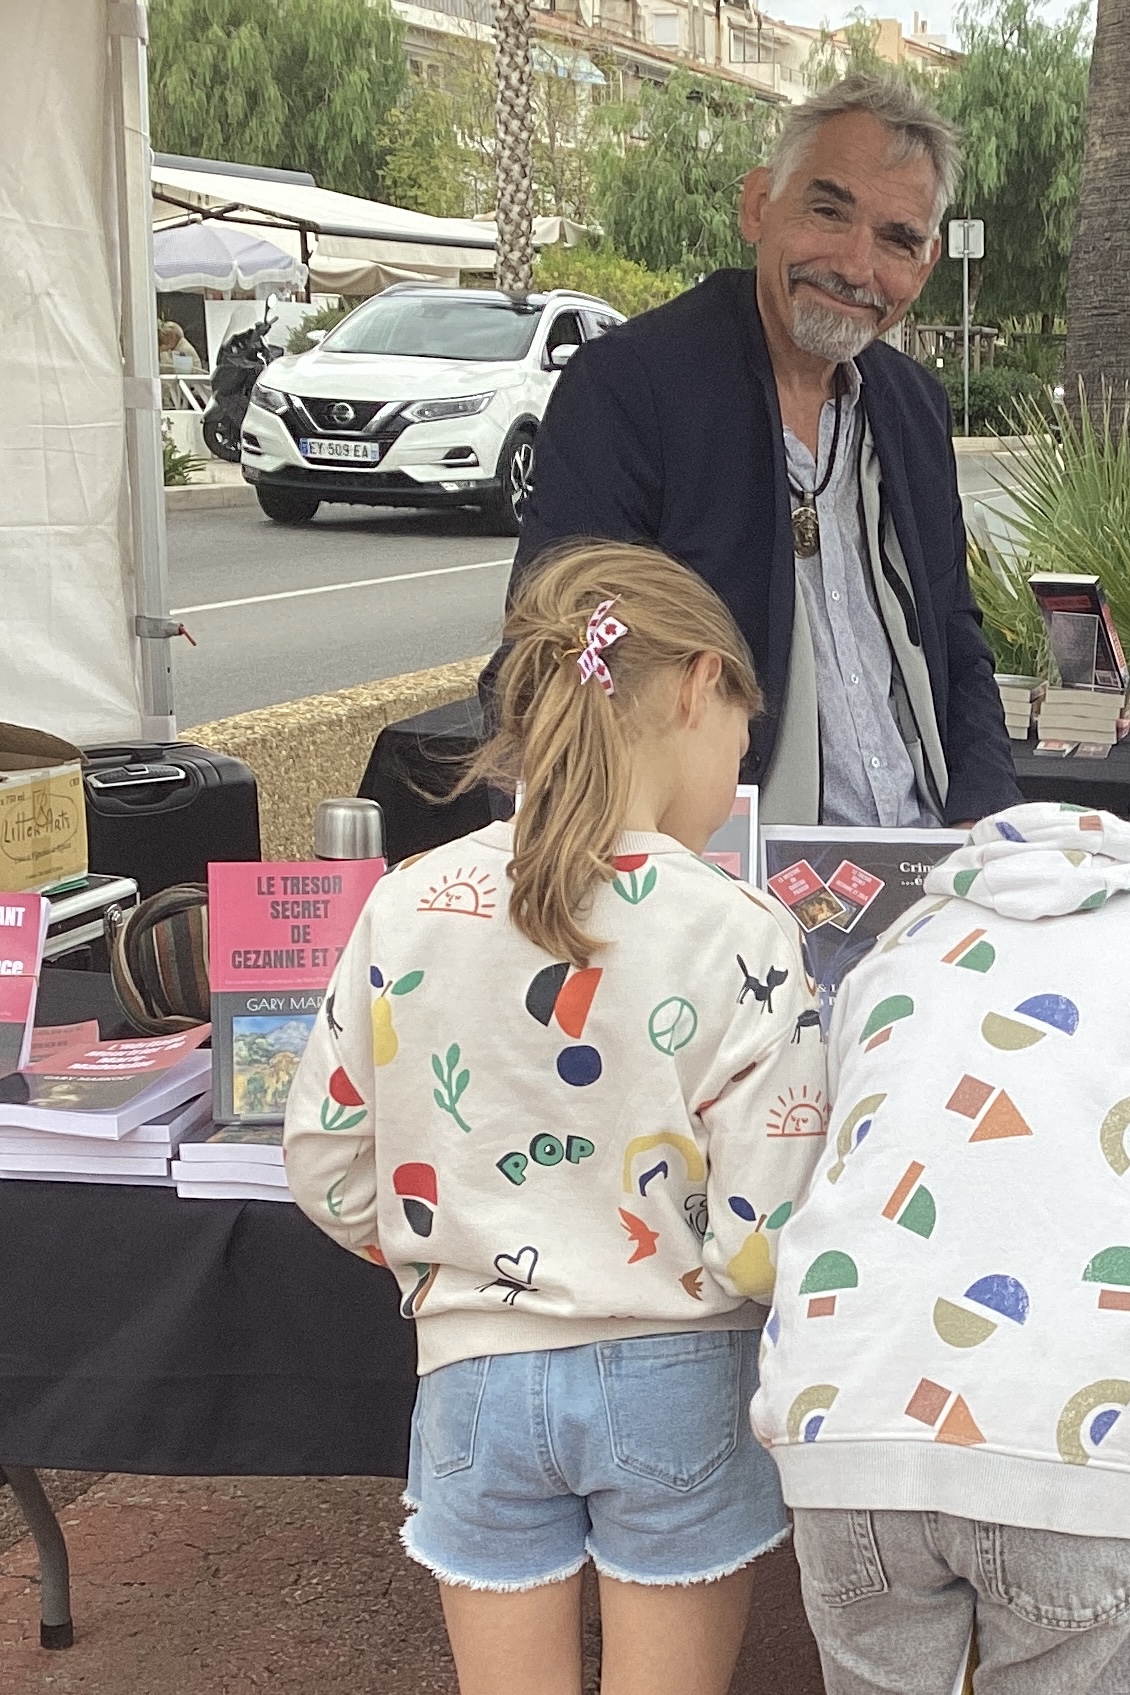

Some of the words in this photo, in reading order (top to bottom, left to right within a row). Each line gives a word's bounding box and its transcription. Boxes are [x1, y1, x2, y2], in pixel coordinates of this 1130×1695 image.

[257, 876, 276, 896] LE
[281, 875, 343, 896] TRESOR
[270, 899, 331, 919] SECRET
[291, 924, 312, 944] DE
[232, 948, 306, 970] CEZANNE
[311, 947, 329, 968] ET
[246, 997, 286, 1012] GARY
[496, 1132, 595, 1186] POP
